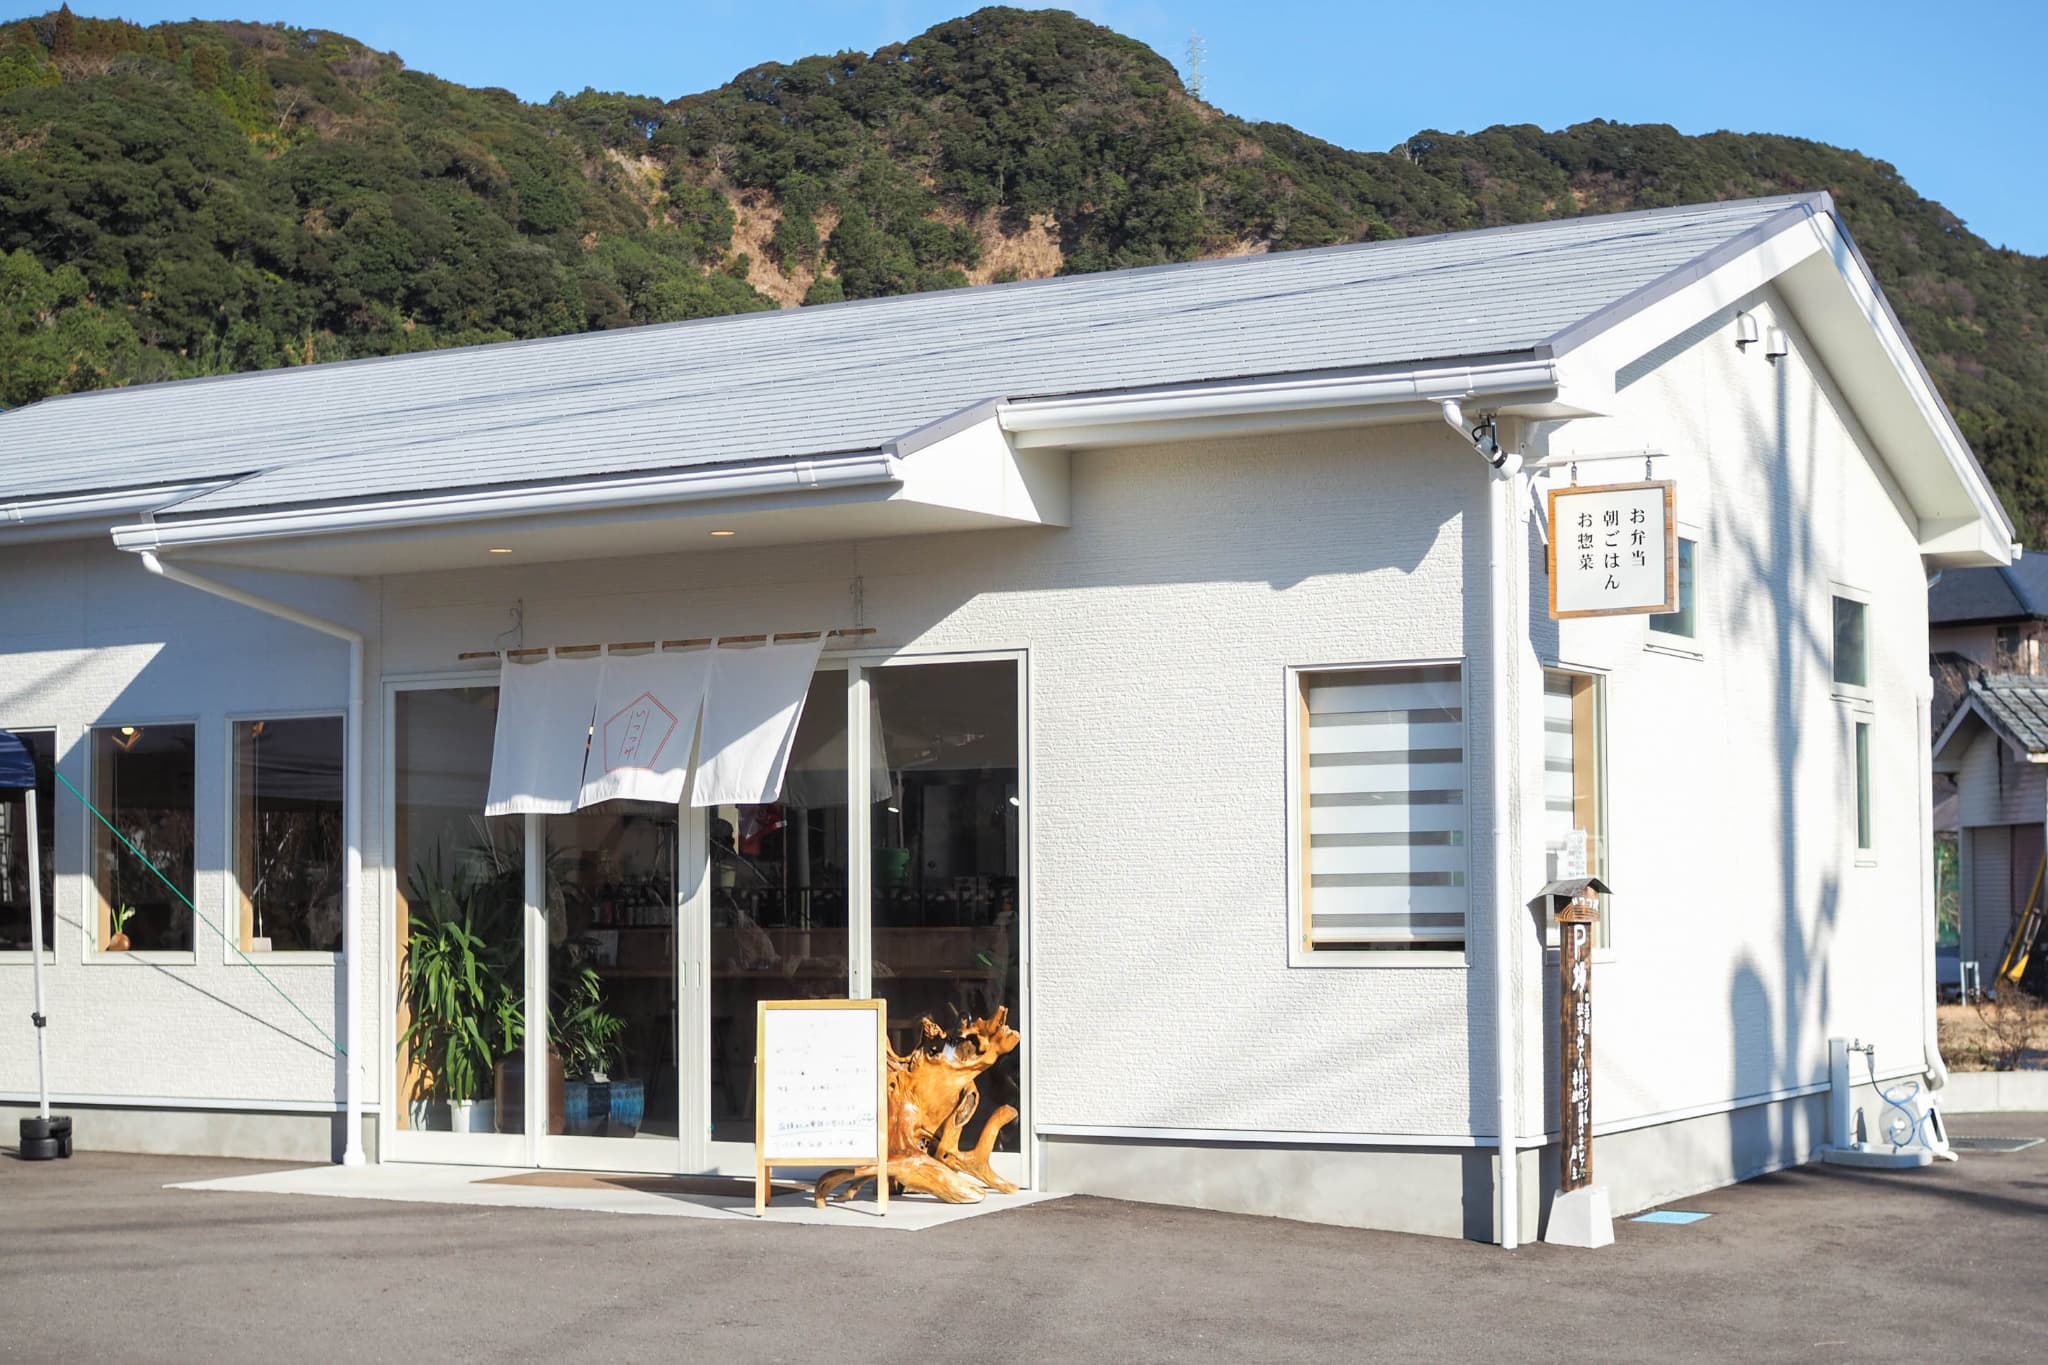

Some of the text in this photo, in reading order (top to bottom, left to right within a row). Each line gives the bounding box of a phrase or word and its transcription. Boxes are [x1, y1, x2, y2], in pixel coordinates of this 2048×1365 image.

[1577, 512, 1594, 571] お惣菜
[1603, 510, 1620, 590] 朝ごはん
[1630, 508, 1646, 567] お弁当
